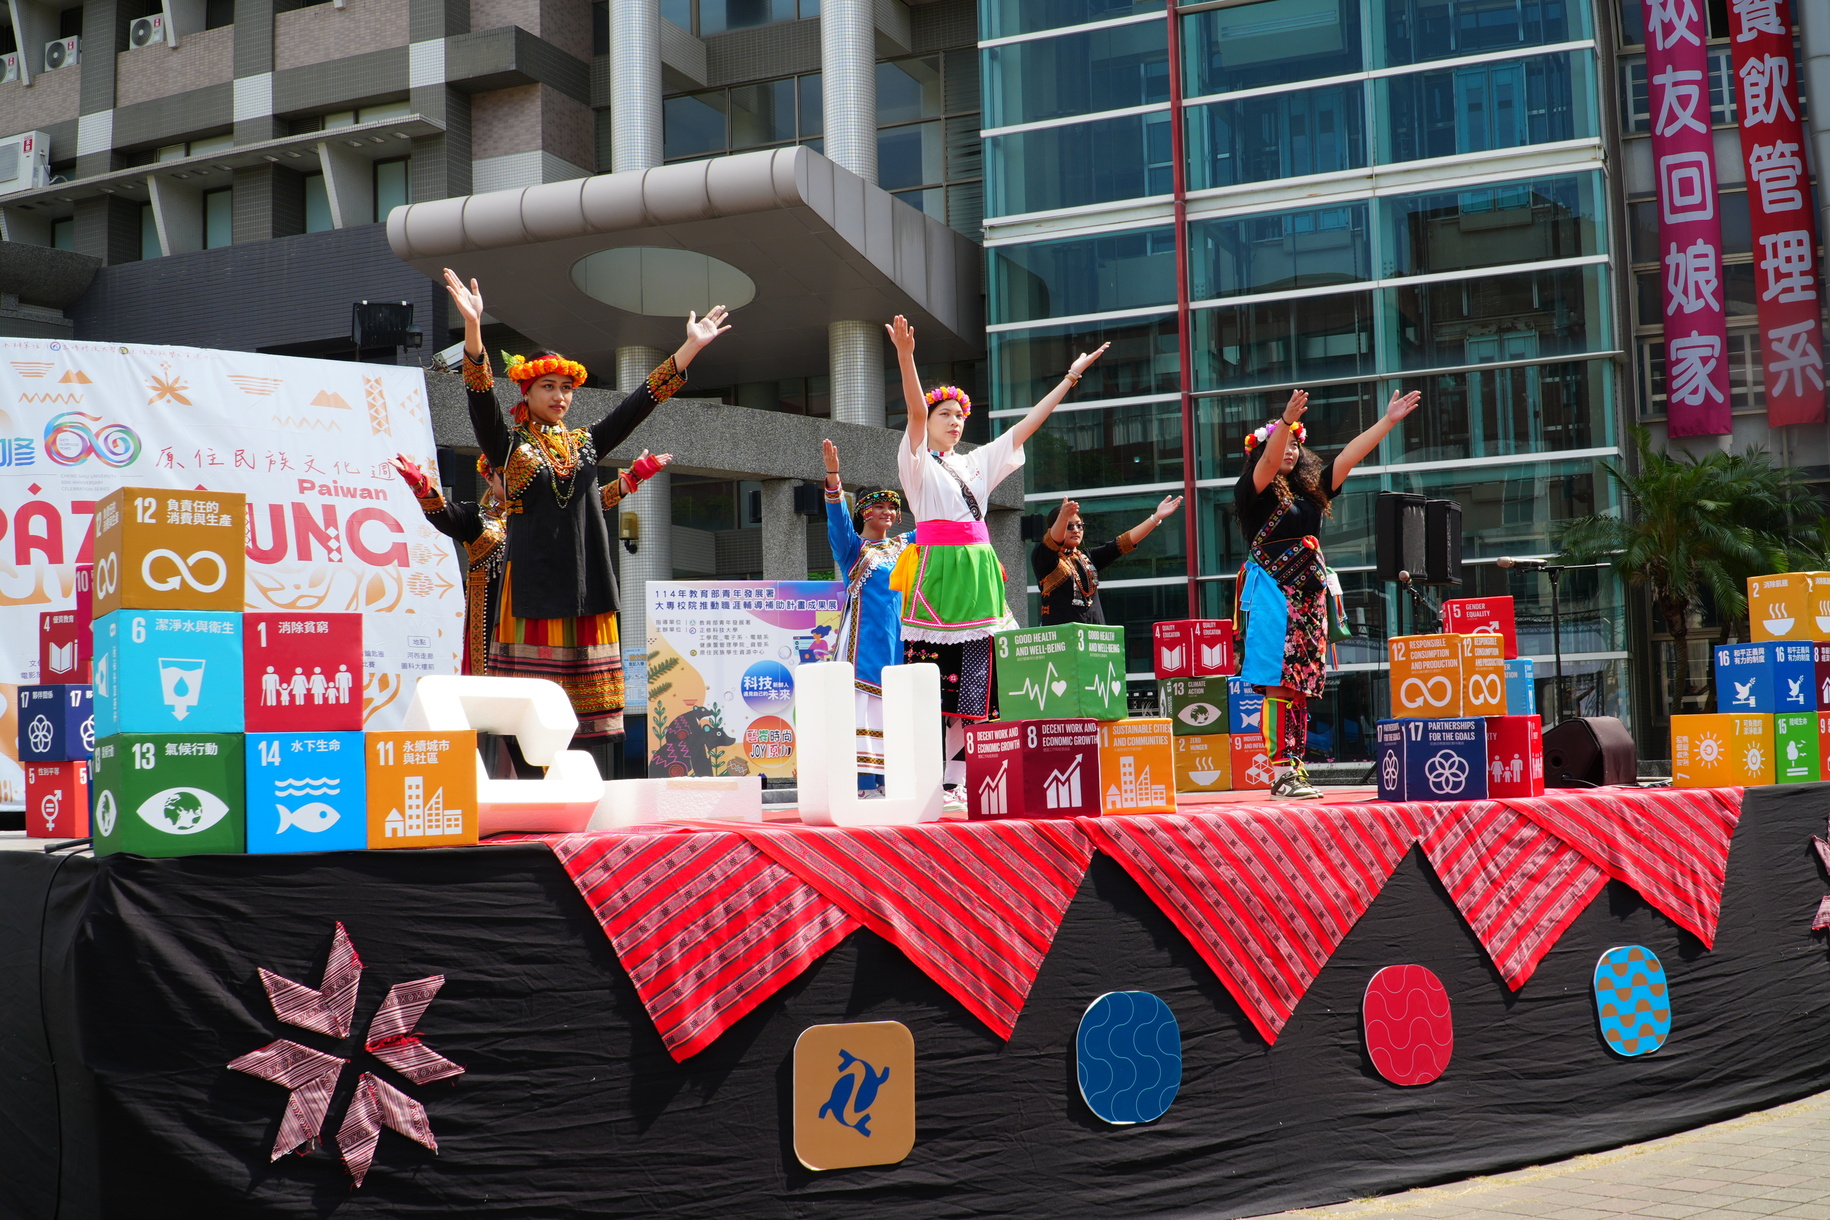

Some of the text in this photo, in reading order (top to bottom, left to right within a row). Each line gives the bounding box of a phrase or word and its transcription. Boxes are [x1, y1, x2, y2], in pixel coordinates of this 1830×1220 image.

[1647, 0, 1724, 405] 校友回娘家
[298, 478, 388, 501] Paiwan
[134, 497, 157, 523] 12
[167, 498, 219, 514] 負責任的
[167, 512, 232, 527] 消費與生產
[77, 570, 89, 592] 10
[655, 589, 775, 598] 114年教育部青年發展署
[1753, 582, 1759, 597] 2
[1453, 604, 1461, 618] 5
[44, 616, 50, 632] 4
[132, 617, 146, 643] 6
[155, 618, 235, 634] 潔淨水與衛生
[278, 621, 329, 634] 消除貧窮
[1195, 622, 1200, 635] 4
[258, 622, 267, 647] 1
[1015, 631, 1056, 644] GOOD HEALTH
[1088, 630, 1114, 641] GOOD HEALTH
[1155, 625, 1160, 638] 4
[999, 637, 1008, 658] 3
[1078, 630, 1084, 651] 3
[1409, 638, 1446, 649] RESPONSIBLE
[1463, 638, 1472, 657] 12
[1474, 637, 1497, 645] RESPONSIBLE
[1016, 642, 1066, 656] AND WELL-BEING
[1089, 643, 1120, 653] AND WELL-BEING
[1392, 642, 1406, 661] 12
[1410, 649, 1449, 659] CONSUMPTION
[1475, 648, 1499, 656] CONSUMPTION
[1734, 648, 1765, 657] 和平正義與
[1775, 647, 1785, 662] 16
[1814, 647, 1819, 662] 8
[1411, 659, 1458, 670] AND PRODUCTION
[1718, 651, 1730, 666] 16
[1734, 656, 1765, 664] 有力的制度
[1173, 682, 1184, 695] 13
[1229, 681, 1240, 694] 14
[21, 692, 29, 708] 17
[70, 690, 81, 707] 17
[1042, 723, 1096, 734] DECENT WORK AND
[1113, 723, 1171, 734] SUSTAINABLE CITIES
[1409, 722, 1423, 741] 17
[1428, 722, 1475, 730] PARTNERSHIPS
[1735, 720, 1740, 735] 7
[1778, 718, 1787, 734] 15
[1820, 718, 1825, 733] 9
[977, 727, 1018, 741] DECENT WORK AND
[1027, 726, 1037, 748] 8
[1043, 734, 1098, 746] ECONOMIC GROWTH
[1377, 725, 1382, 742] 17
[1429, 732, 1475, 741] FOR THE GOALS
[291, 740, 341, 752] 水下生命
[403, 740, 450, 752] 永續城市
[966, 732, 974, 754] 8
[977, 739, 1020, 753] ECONOMIC GROWTH
[1114, 736, 1168, 746] AND COMMUNITIES
[1179, 739, 1185, 751] 2
[1235, 737, 1242, 750] 9
[132, 743, 155, 769] 13
[165, 743, 218, 756] 氣候行動
[258, 741, 281, 766] 14
[377, 741, 394, 765] 11
[403, 752, 439, 764] 與社區
[29, 768, 35, 784] 5
[80, 768, 87, 784] 5
